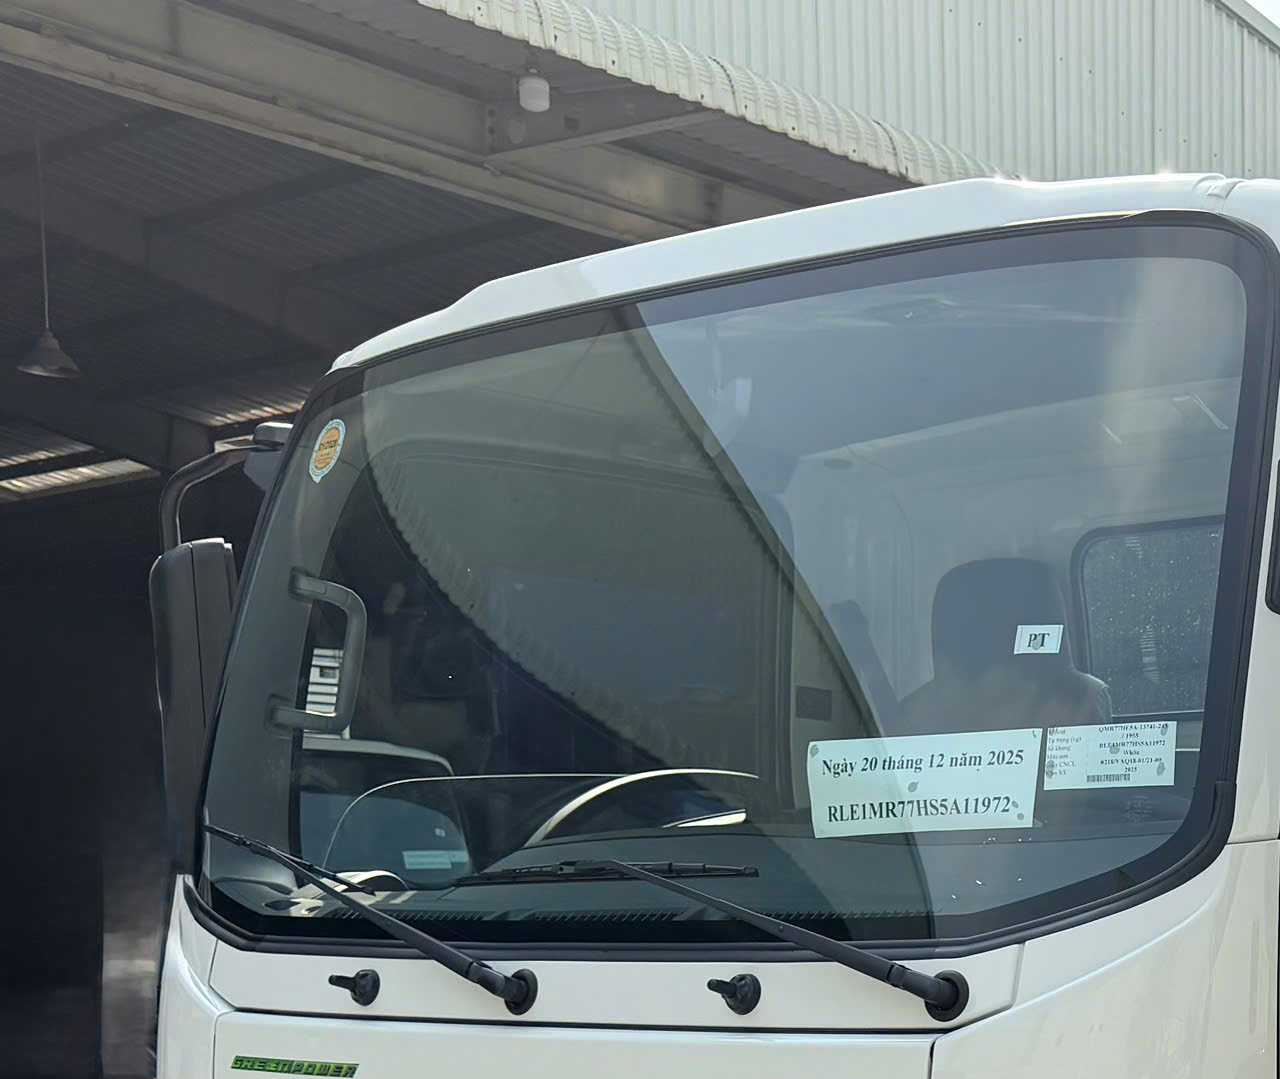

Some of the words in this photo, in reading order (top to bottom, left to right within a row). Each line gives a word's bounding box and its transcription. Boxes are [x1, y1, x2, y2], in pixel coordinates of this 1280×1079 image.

[1027, 632, 1050, 648] PT
[821, 757, 857, 779] Ngày
[861, 756, 879, 773] 20
[881, 753, 924, 774] tháng
[928, 752, 946, 769] 12
[949, 751, 983, 769] năm
[986, 749, 1025, 767] 2025
[827, 796, 1012, 824] RLE1MR77HS5A11972
